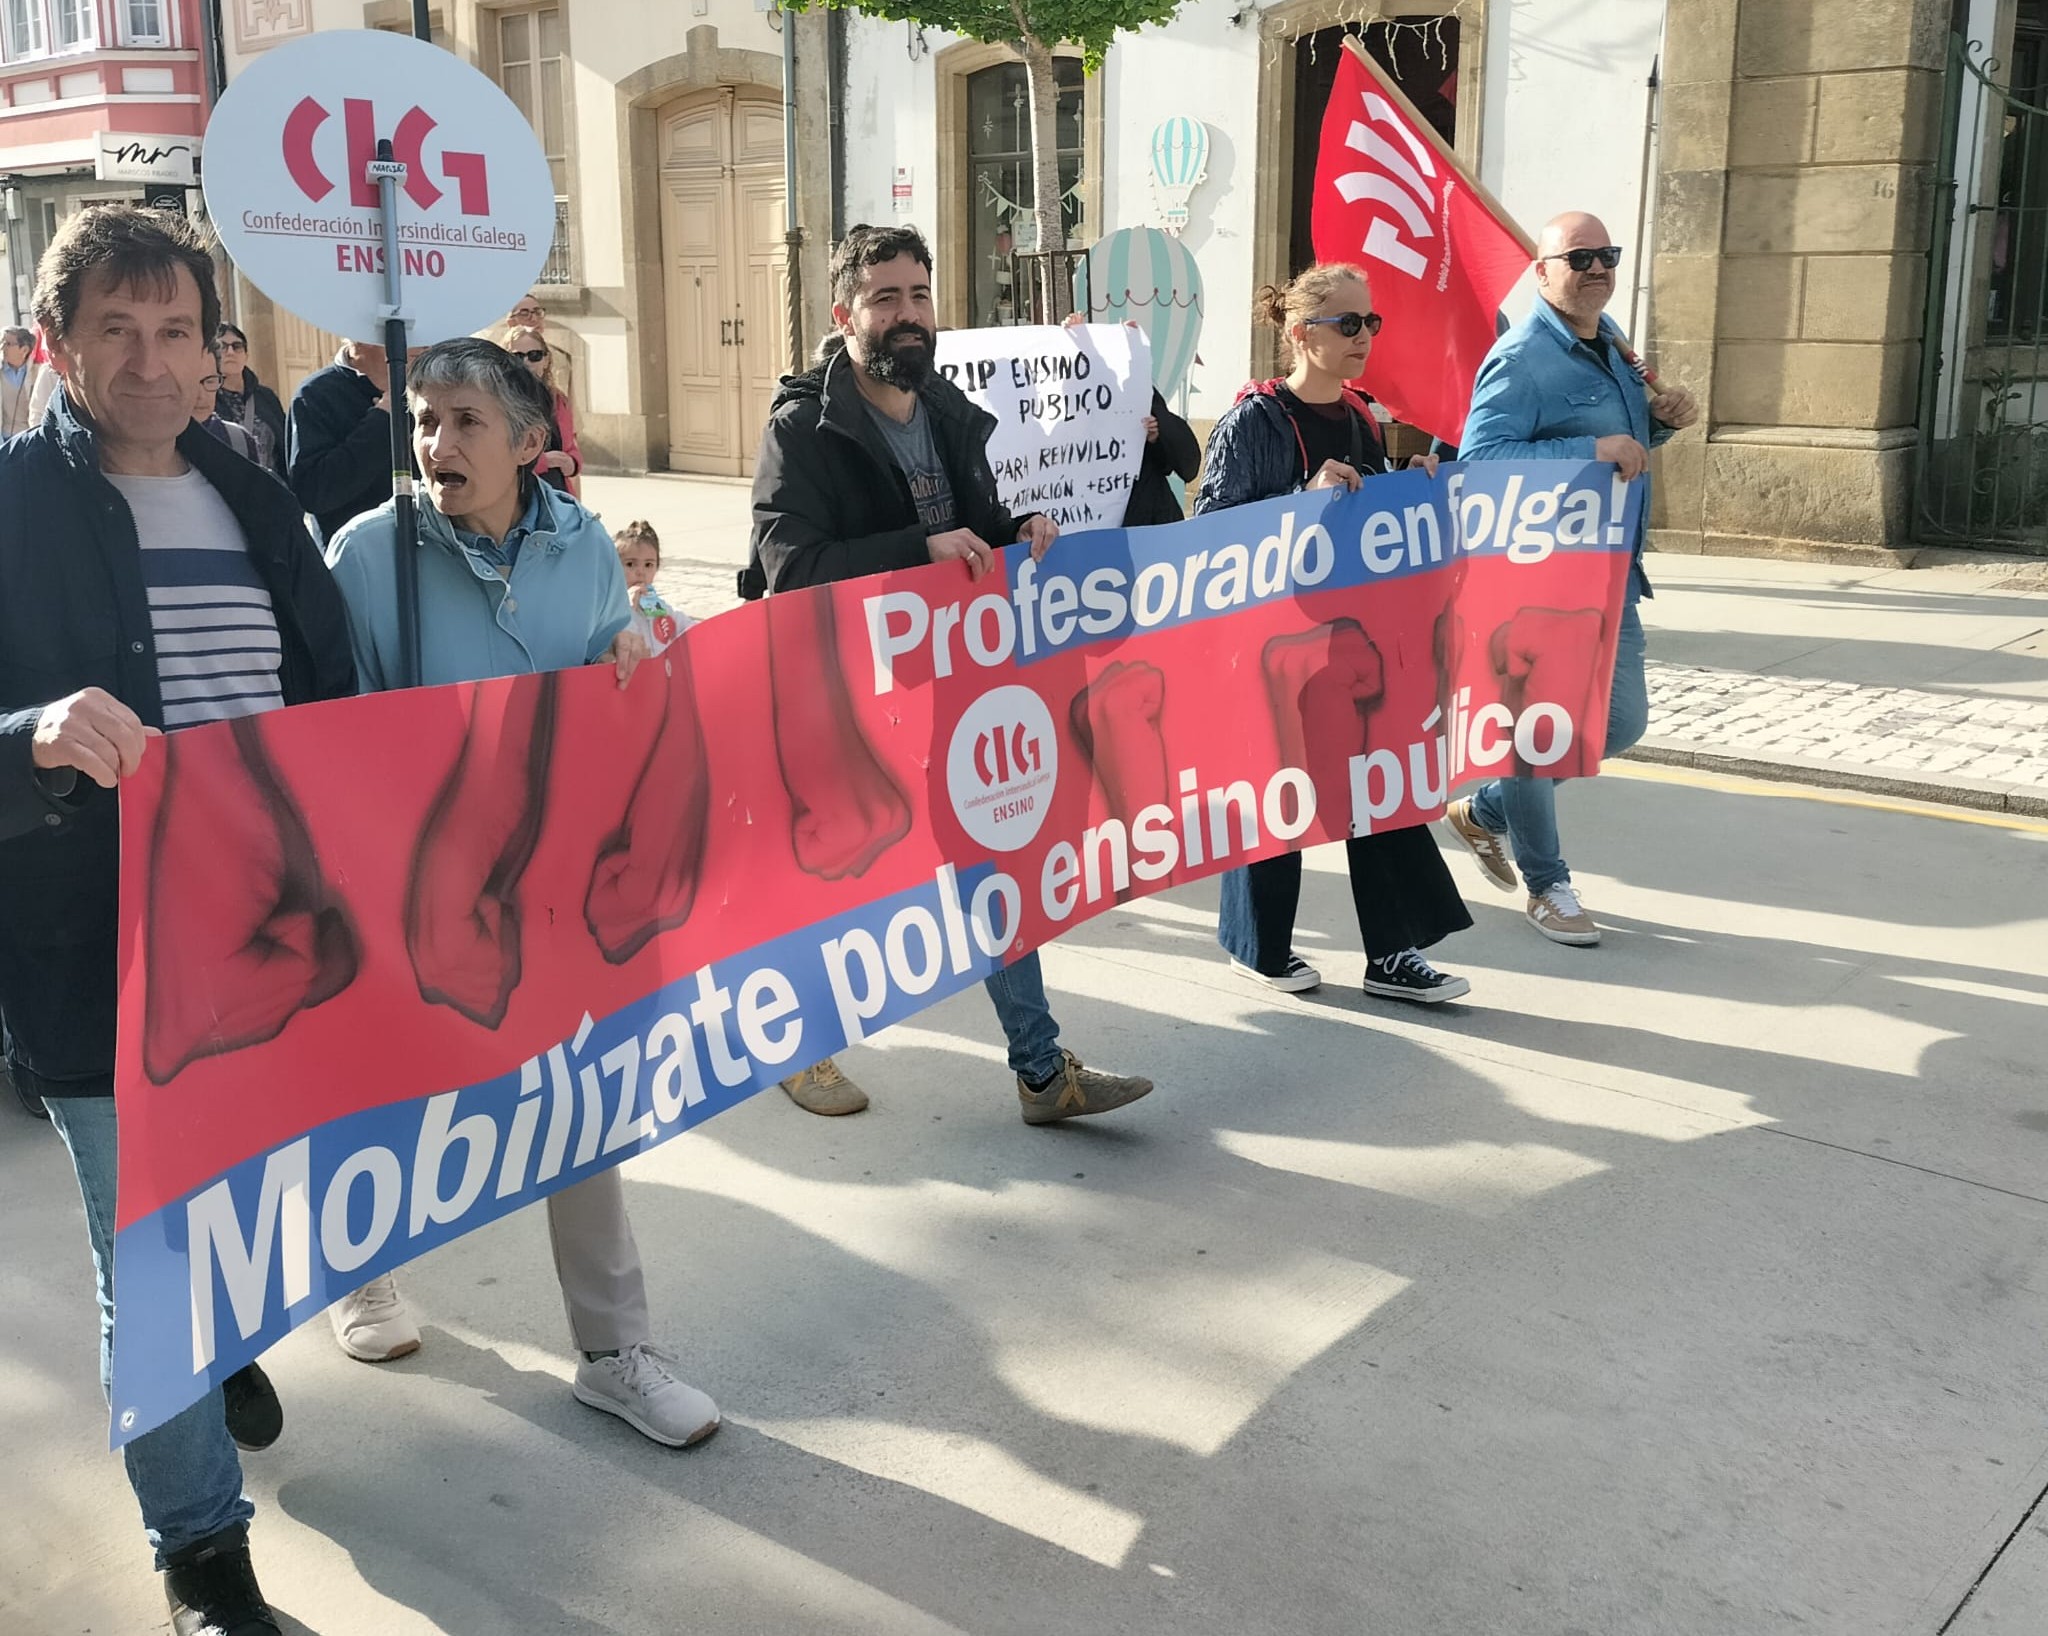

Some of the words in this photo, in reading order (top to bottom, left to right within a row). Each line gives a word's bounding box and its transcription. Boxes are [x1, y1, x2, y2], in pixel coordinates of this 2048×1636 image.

[282, 95, 490, 216] CIG
[242, 209, 363, 236] Confederación
[368, 217, 467, 243] Inrsindical
[472, 225, 527, 250] Galega
[336, 244, 446, 278] ENSNO
[1011, 351, 1091, 388] ENSINO
[995, 455, 1029, 482] PARA
[863, 510, 1335, 695] Profesorado
[1360, 501, 1443, 574] en
[1447, 472, 1629, 564] folga!
[974, 721, 1041, 787] CIG
[993, 795, 1034, 823] ENSINO
[187, 963, 801, 1375] Mobilízate
[821, 863, 1022, 1045] polo
[1040, 768, 1318, 922] ensino
[1349, 686, 1573, 838] púlico
